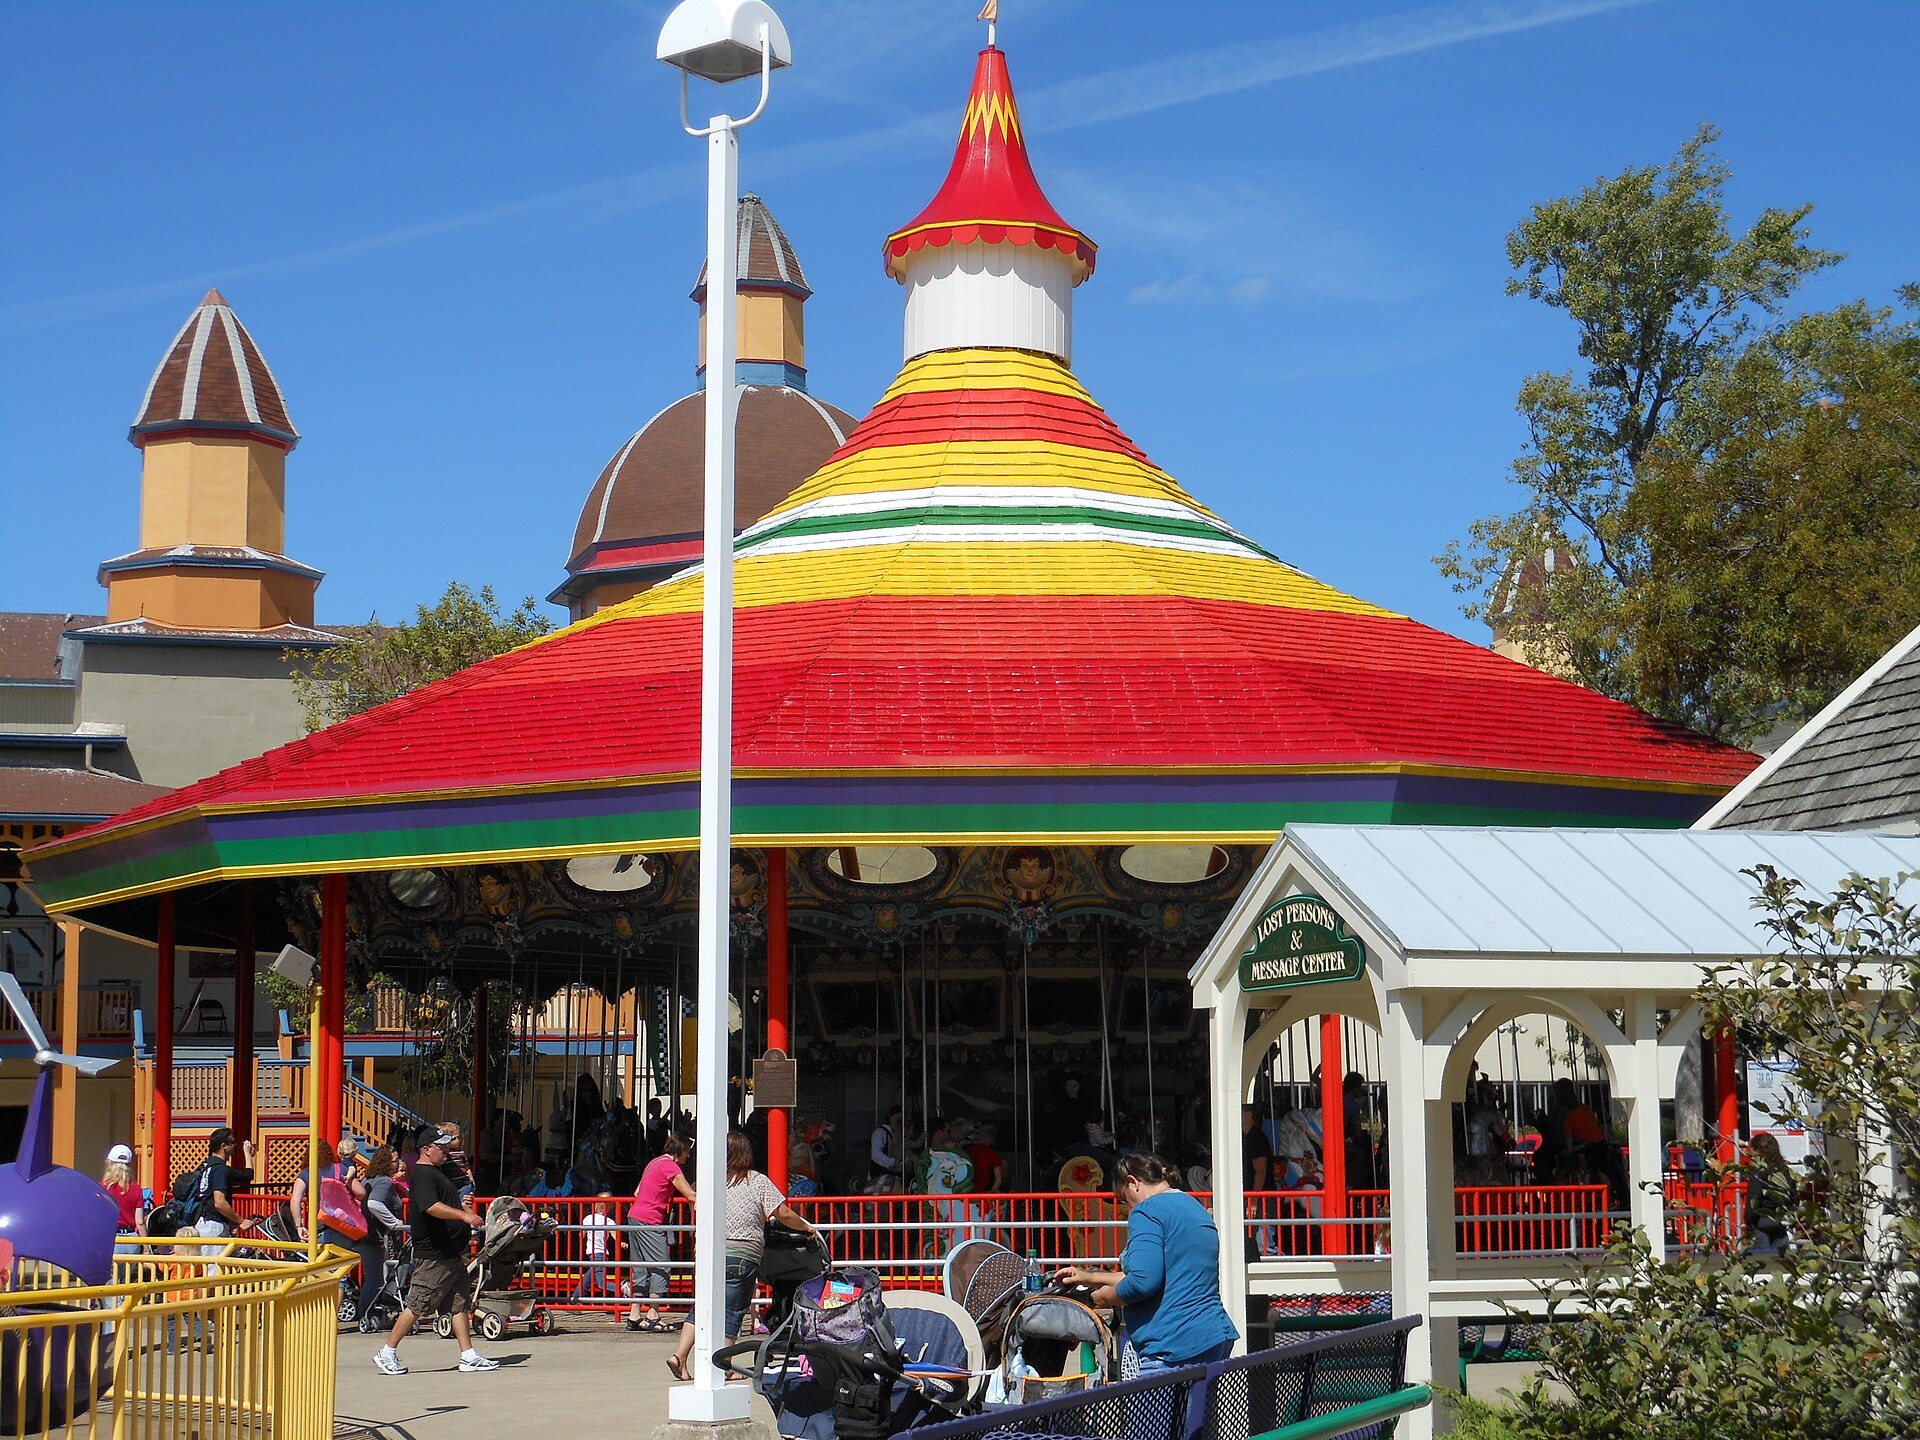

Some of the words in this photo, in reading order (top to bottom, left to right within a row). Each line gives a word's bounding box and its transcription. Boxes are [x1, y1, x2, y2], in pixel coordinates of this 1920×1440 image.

[1257, 908, 1283, 943] LOST
[1286, 902, 1335, 931] PERSONS
[1290, 929, 1303, 951] &
[1251, 956, 1300, 981] MESSAGE
[1302, 951, 1346, 975] CENTER
